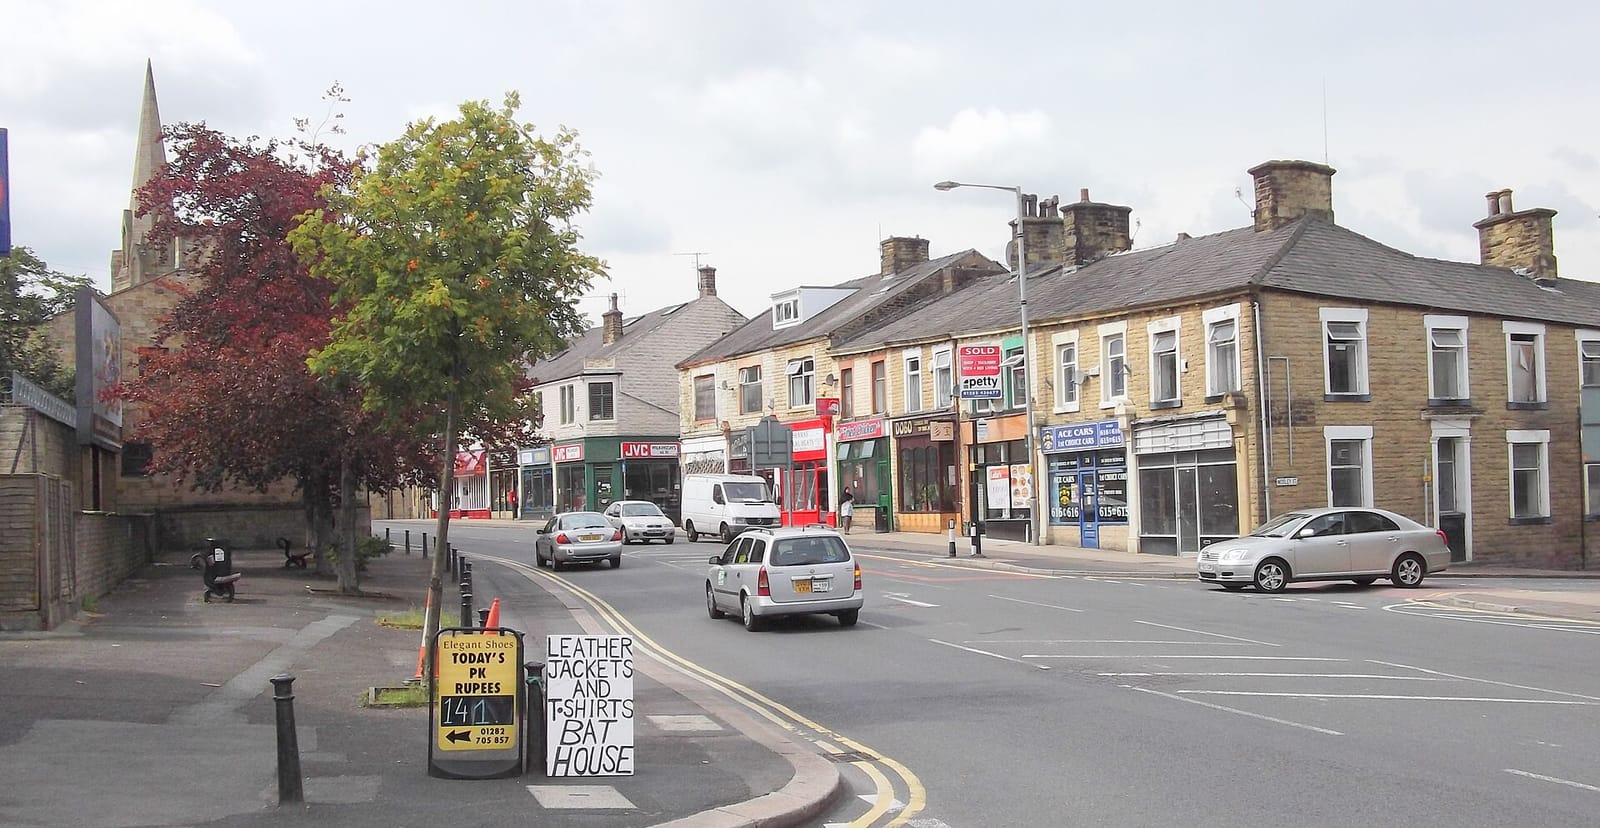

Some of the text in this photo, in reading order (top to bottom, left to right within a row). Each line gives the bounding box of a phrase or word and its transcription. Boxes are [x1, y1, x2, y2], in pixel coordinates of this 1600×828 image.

[966, 347, 995, 355] SOLD
[970, 377, 998, 389] petty
[1073, 428, 1094, 437] CARS
[625, 444, 648, 456] JVC
[443, 640, 514, 651] Elegant Shoes
[548, 637, 633, 658] LEATHER
[452, 652, 505, 664] TODAY'S
[469, 667, 487, 679] PK
[548, 659, 633, 679] JACKETS
[455, 682, 501, 694] RUPEES
[573, 680, 611, 699] AND
[560, 719, 617, 745] BAT
[494, 736, 509, 744] 857
[552, 745, 634, 777] HOUSE
